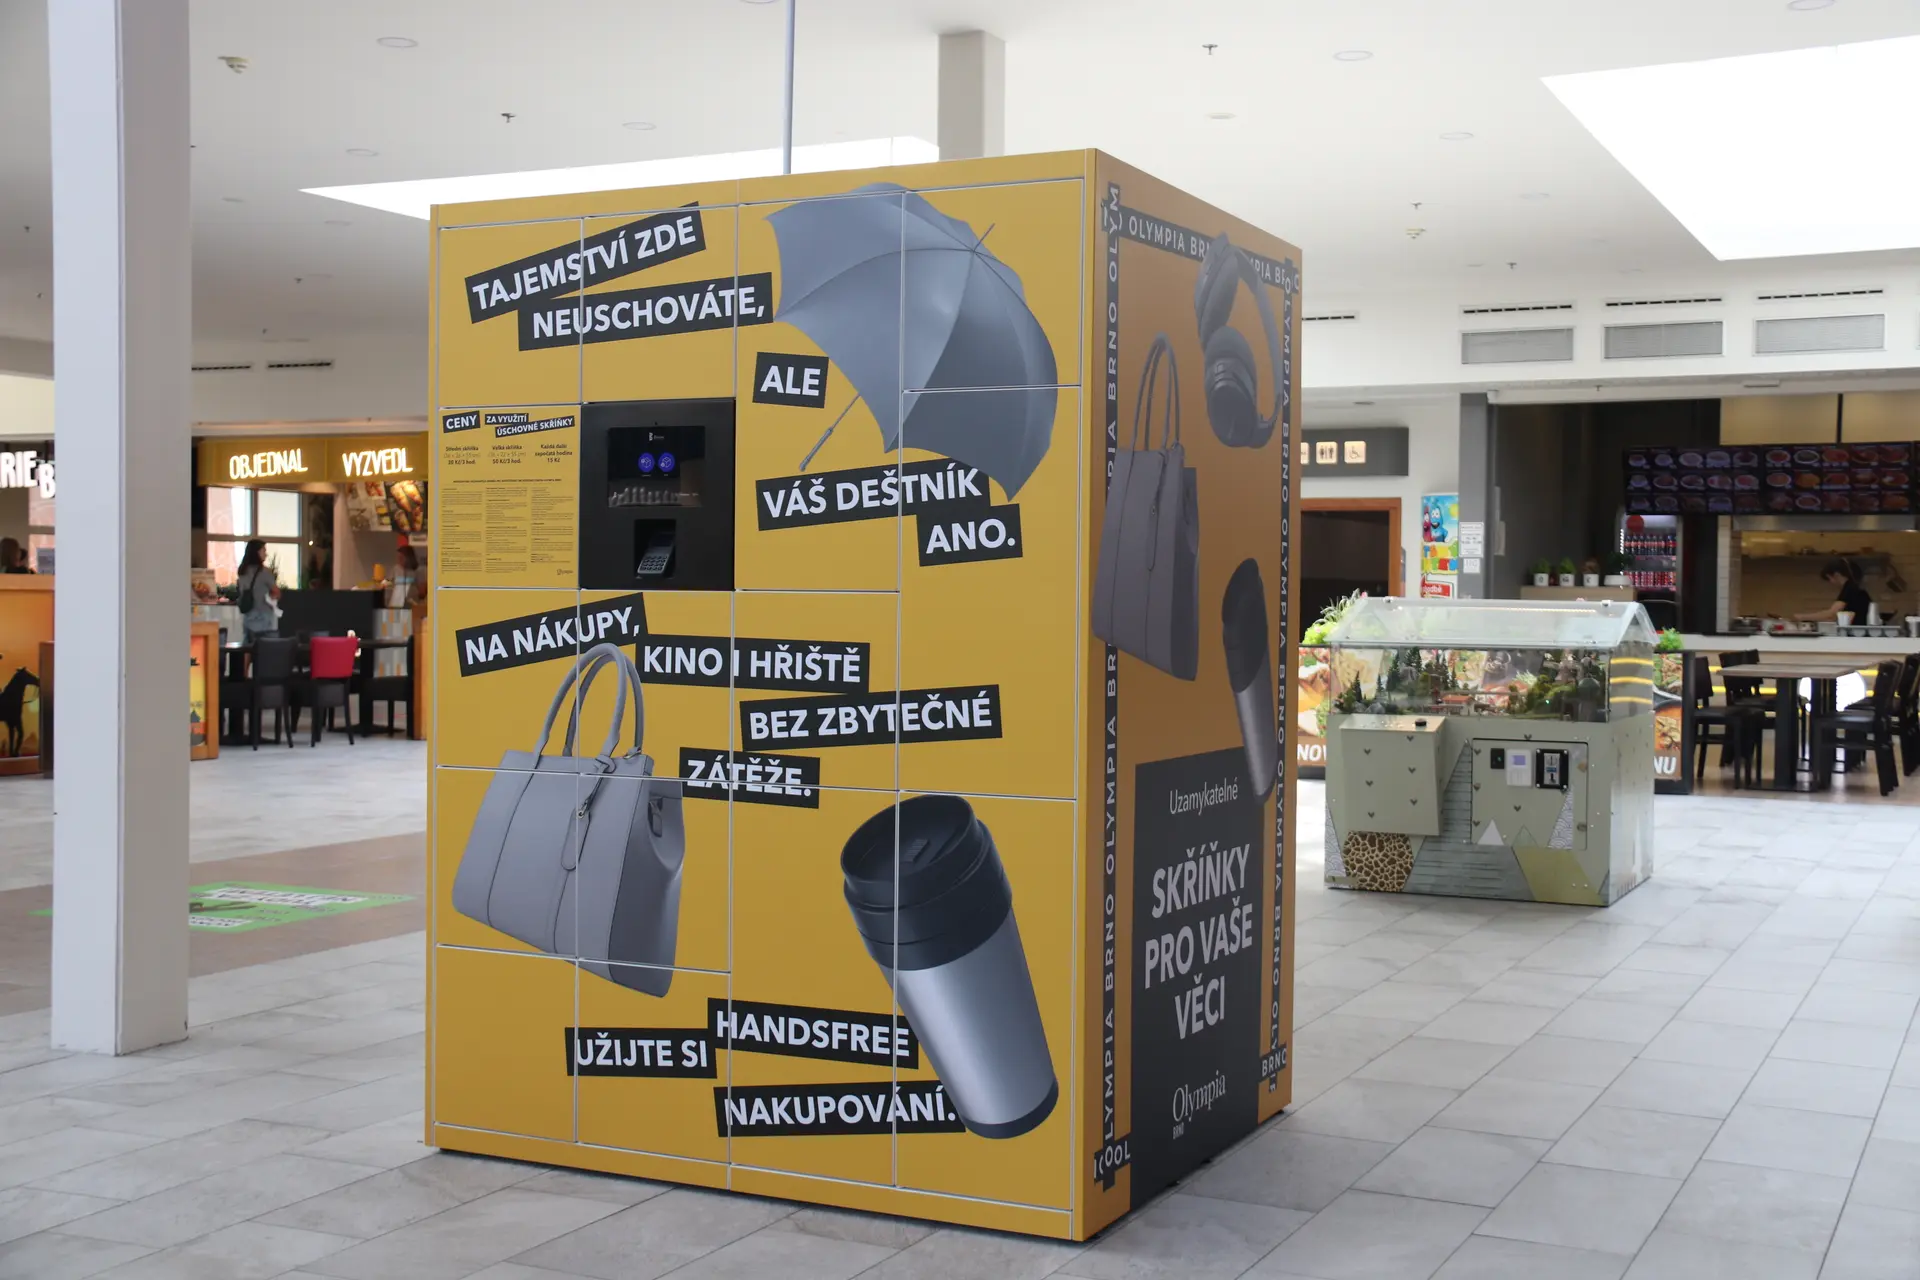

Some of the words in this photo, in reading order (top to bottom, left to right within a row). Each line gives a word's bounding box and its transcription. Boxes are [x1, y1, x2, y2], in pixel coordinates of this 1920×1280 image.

[1128, 215, 1185, 252] OLYMPIA
[1190, 237, 1209, 258] BR
[472, 230, 630, 310] TAJEMSTVÍ
[634, 215, 697, 259] ZDE
[532, 285, 765, 339] NEUSCHOVÁTE,
[1107, 301, 1117, 400] BRNO
[760, 365, 821, 396] ALE
[446, 414, 477, 429] CENY
[497, 414, 527, 423] VYUŽITÍ
[540, 418, 573, 430] SKŘÍŇKY
[0, 451, 38, 488] RIE
[229, 448, 308, 480] OBJEDNAL
[341, 447, 413, 477] VYZVEDL
[763, 478, 827, 518] VÁŠ
[836, 463, 982, 511] DEŠTNÍK
[926, 518, 1016, 554] ANO.
[1280, 518, 1288, 647] OLYMPIA
[465, 637, 508, 665] NA
[513, 606, 640, 656] NÁKUPY,
[643, 646, 723, 676] KINO
[750, 644, 861, 683] HŘIŠTĚ
[750, 709, 809, 740] BEZ
[817, 691, 993, 736] ZBYTEČNÉ
[687, 755, 812, 797] ZÁTĚŽE.
[1106, 716, 1116, 875] OLYMPIA
[1169, 777, 1239, 816] Uzamykatelné
[1152, 841, 1250, 919] SKŘÍŇKY
[1104, 893, 1114, 992] BRNO
[1145, 925, 1194, 990] PRO
[1199, 896, 1252, 965] VAŠE
[1174, 973, 1225, 1040] VĚCI
[576, 1032, 673, 1067] UŽIJTE
[681, 1039, 708, 1068] SI
[716, 1010, 910, 1057] HANDSFREE
[724, 1085, 956, 1126] NAKUPOVÁNÍ.
[1172, 1069, 1226, 1123] Olympia
